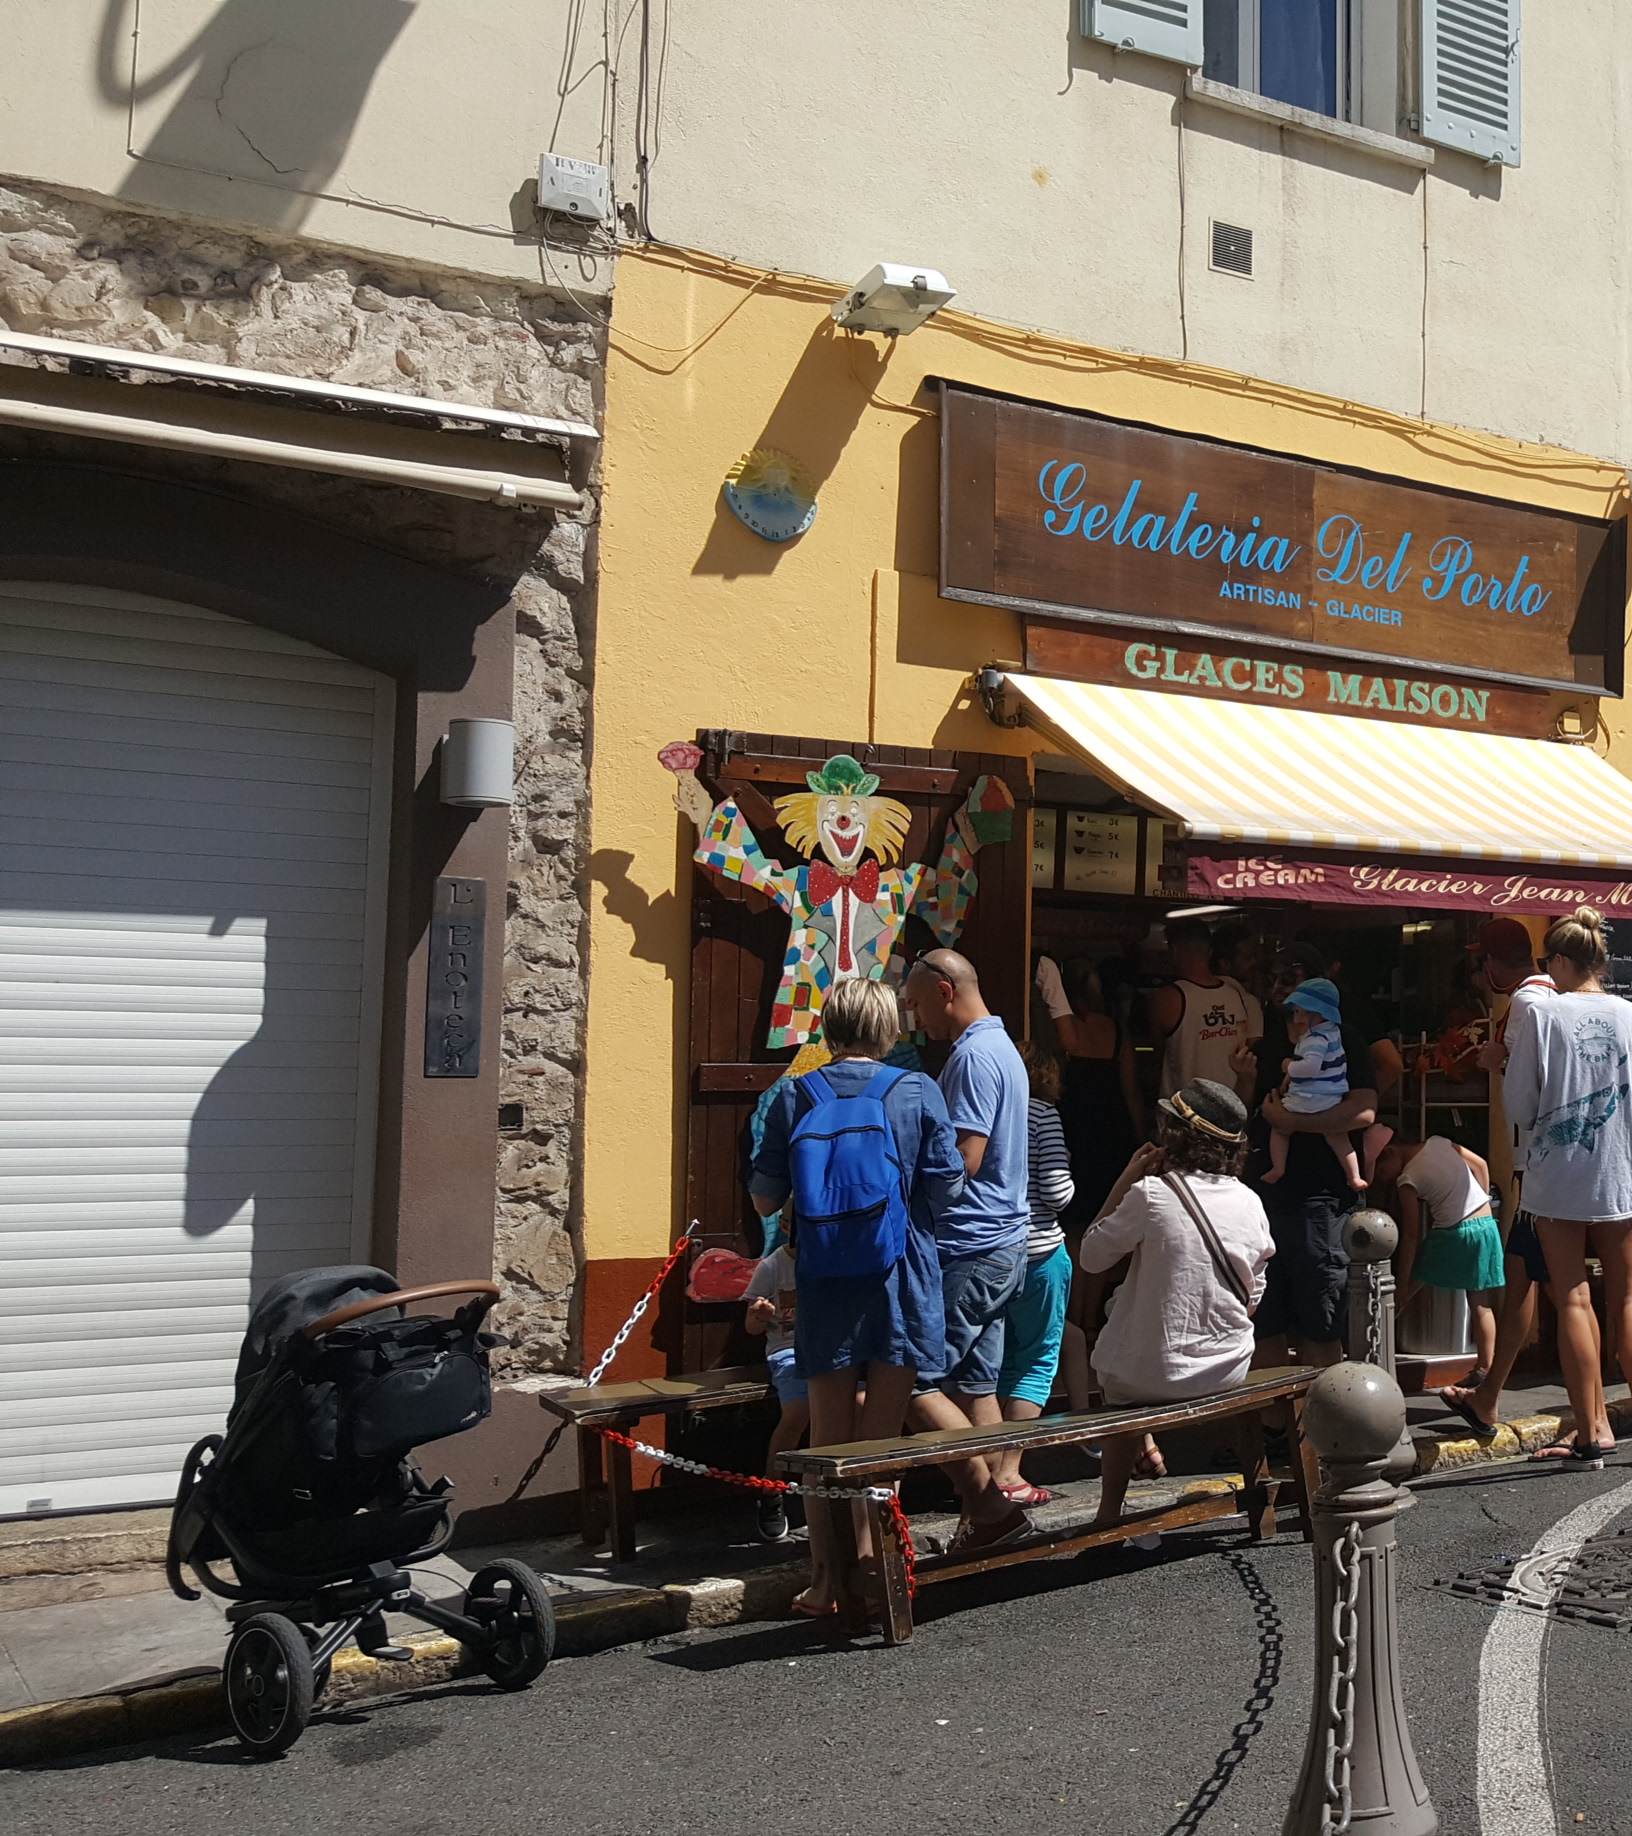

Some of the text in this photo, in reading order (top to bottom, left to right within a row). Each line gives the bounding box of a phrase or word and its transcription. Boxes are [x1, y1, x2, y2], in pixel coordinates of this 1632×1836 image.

[1038, 459, 1552, 616] Gelateria Del Porto
[1219, 581, 1301, 609] ARTISAN
[1326, 600, 1402, 627] GLACIER
[1124, 641, 1490, 721] GLACES MAISON
[1108, 818, 1120, 826] 3€
[1108, 832, 1120, 840] 5€
[1108, 851, 1120, 859] 7€
[1237, 855, 1283, 871] ICE
[1217, 867, 1326, 889] CREAM
[1350, 863, 1493, 896] Glacier
[1490, 874, 1595, 906] Jean
[1573, 1020, 1587, 1038] ALL
[1587, 1017, 1617, 1038] ABOUT
[1575, 1045, 1592, 1062] THE
[1594, 1045, 1615, 1063] BAIT
